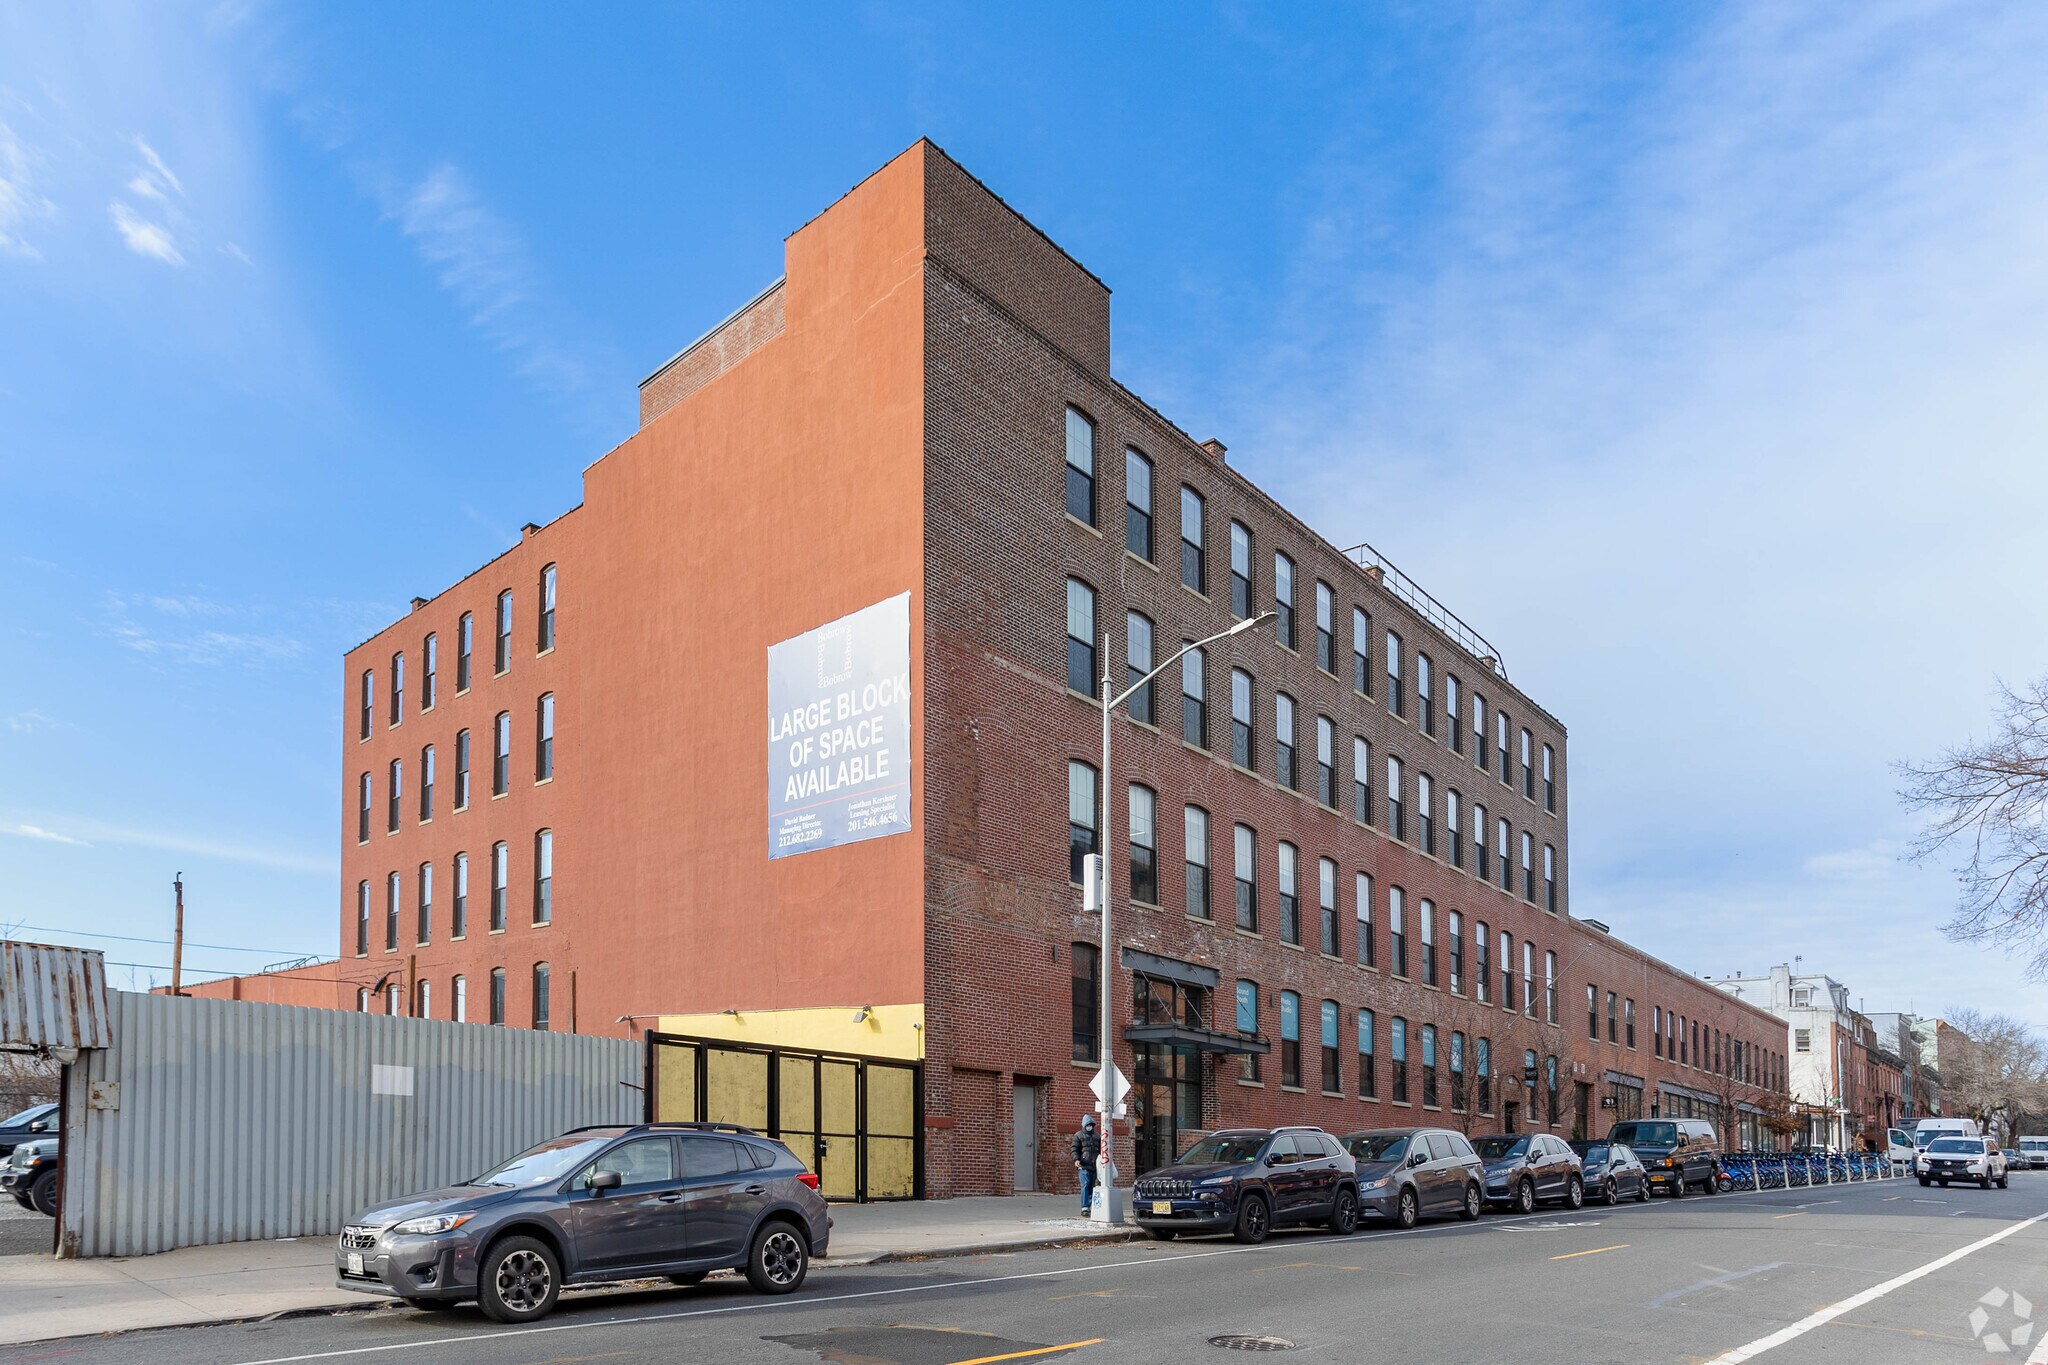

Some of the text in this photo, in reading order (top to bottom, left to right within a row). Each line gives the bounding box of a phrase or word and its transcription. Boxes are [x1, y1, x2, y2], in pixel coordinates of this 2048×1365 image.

[771, 672, 907, 742] LARGE BLOCK
[789, 715, 884, 768] OF SPACE
[785, 748, 890, 802] AVAILABLE
[848, 800, 871, 811] Jonathan
[850, 802, 896, 819] Leasing Specialist
[779, 820, 822, 835] Managing Director
[848, 811, 898, 832] 201.546.4656
[778, 828, 822, 848] 212.682.2269
